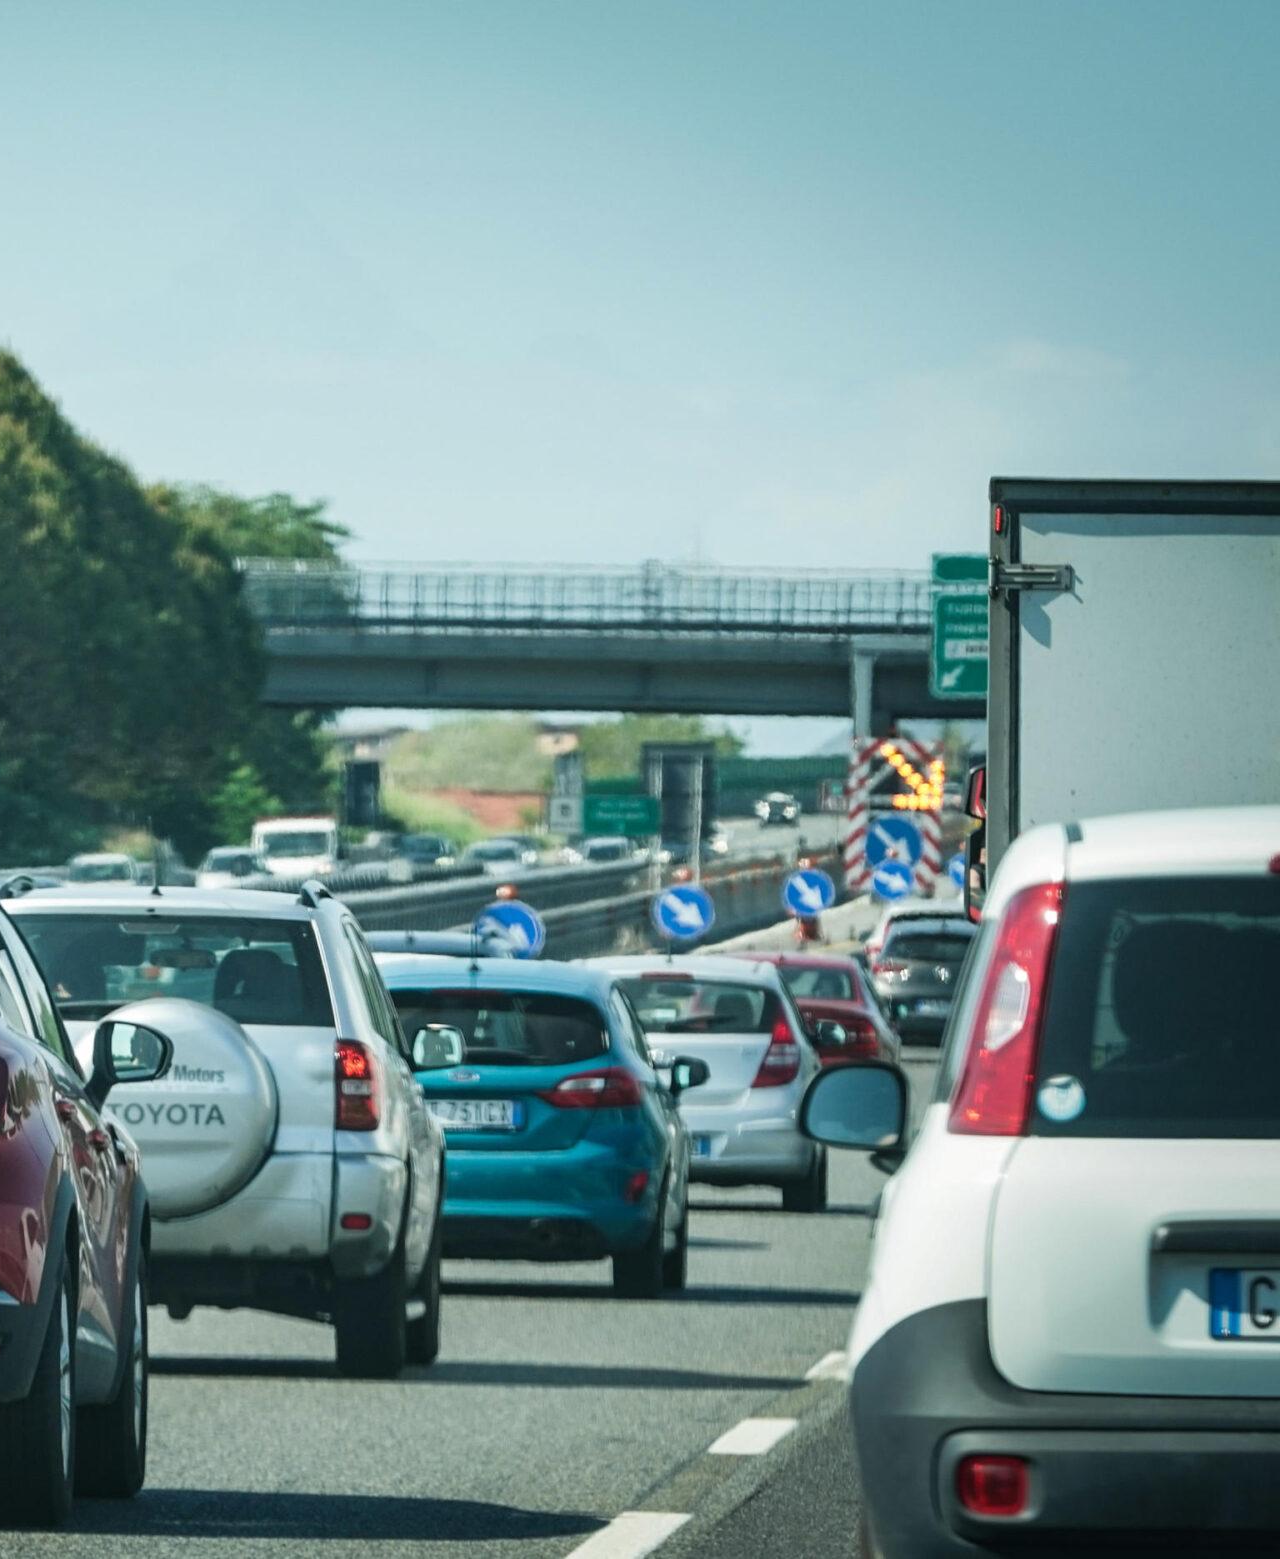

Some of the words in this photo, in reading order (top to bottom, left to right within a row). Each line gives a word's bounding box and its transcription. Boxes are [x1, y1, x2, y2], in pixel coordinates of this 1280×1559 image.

[173, 1065, 225, 1083] Motors
[109, 1102, 226, 1126] TOYOTA
[1249, 1277, 1275, 1328] G
